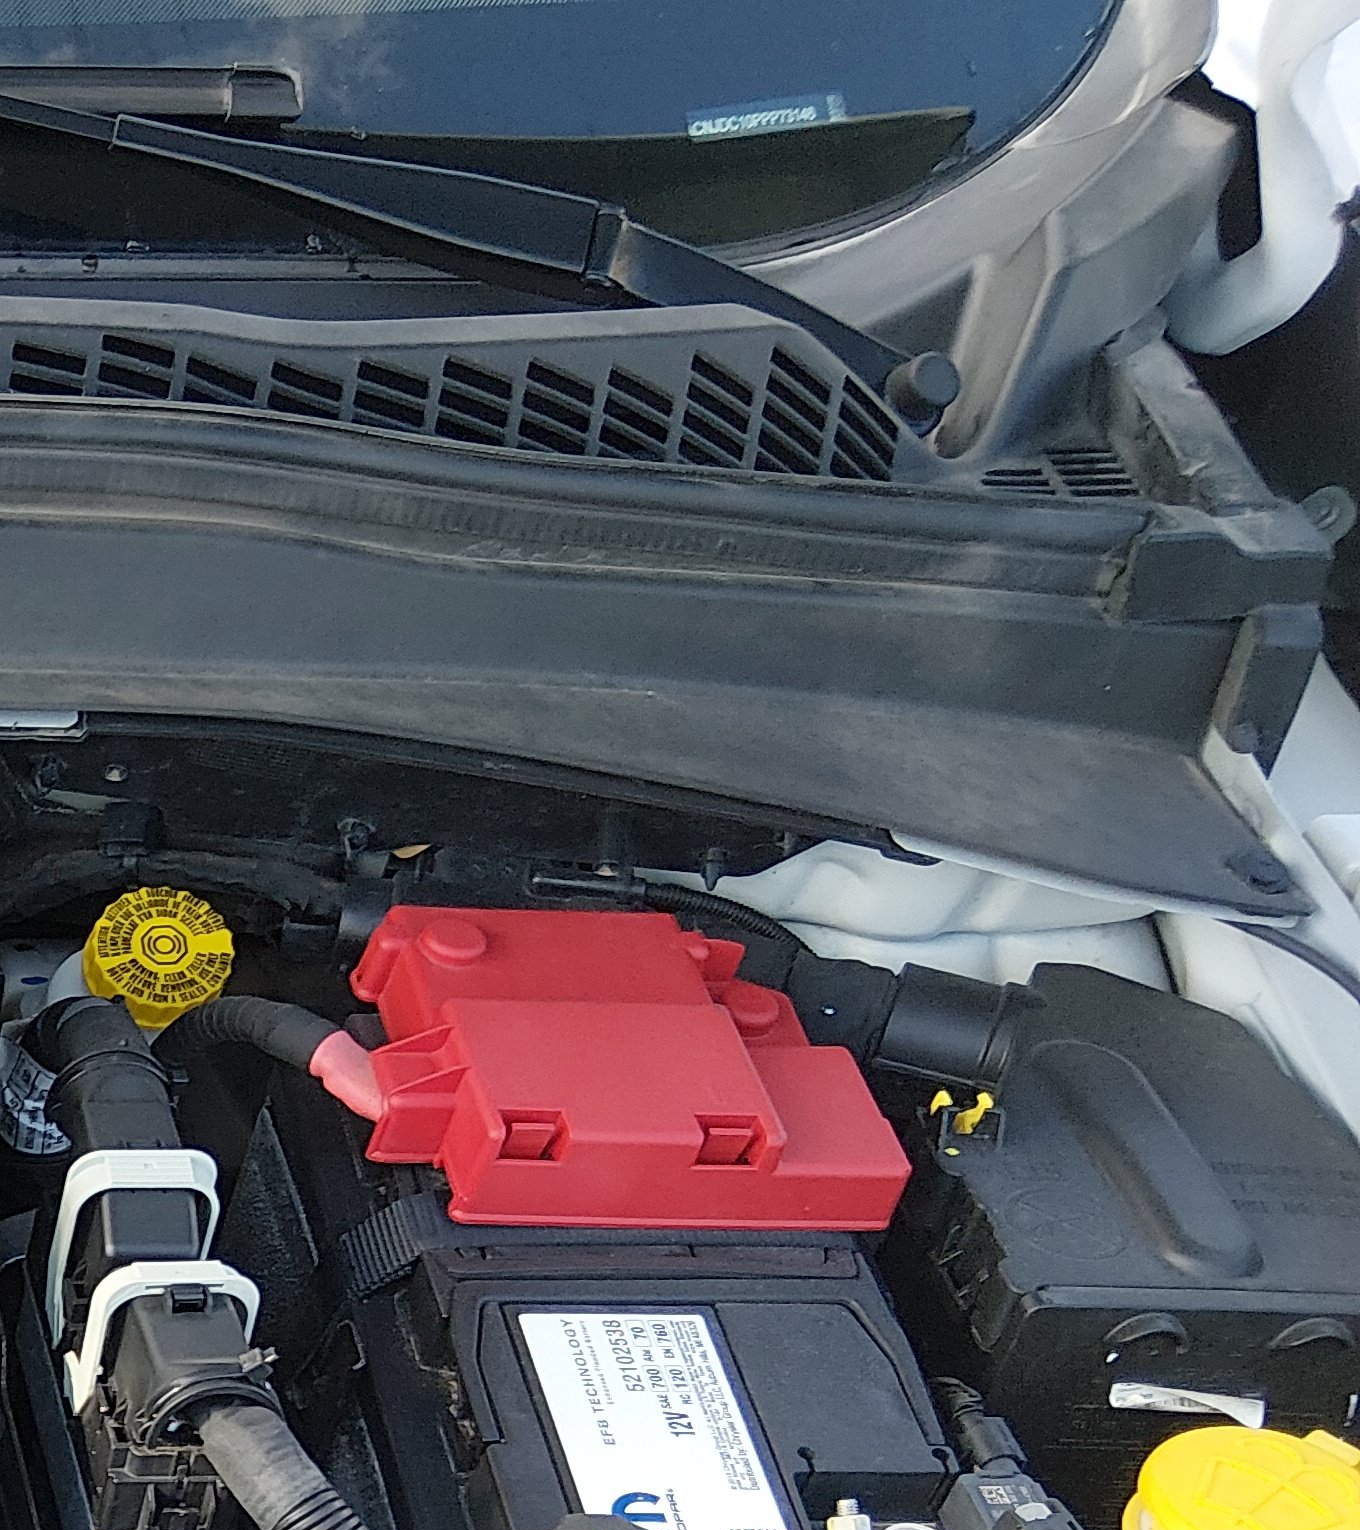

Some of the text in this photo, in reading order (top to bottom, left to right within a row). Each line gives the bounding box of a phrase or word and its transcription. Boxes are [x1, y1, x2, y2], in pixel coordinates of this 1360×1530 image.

[629, 1325, 648, 1339] 70
[650, 1322, 671, 1343] 760
[600, 1319, 646, 1391] 52102538
[558, 1318, 617, 1445] EFB TECHNOLOGY
[644, 1367, 666, 1388] 700
[667, 1368, 689, 1388] 120
[661, 1410, 697, 1437] 12V
